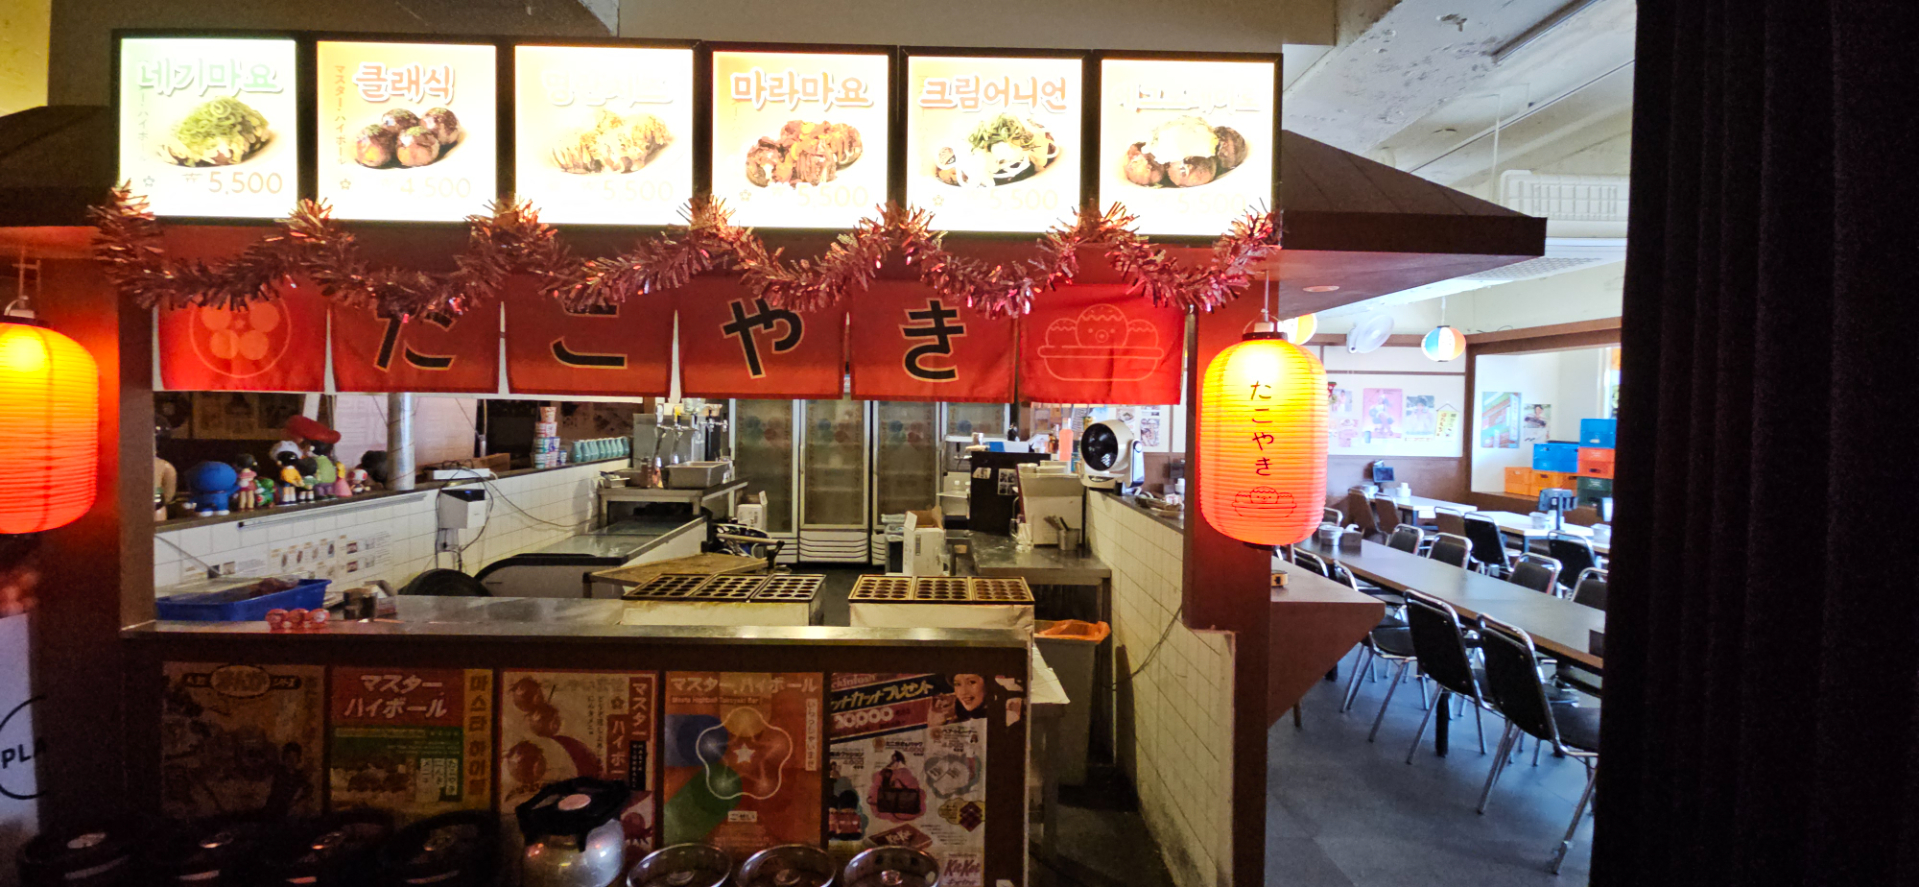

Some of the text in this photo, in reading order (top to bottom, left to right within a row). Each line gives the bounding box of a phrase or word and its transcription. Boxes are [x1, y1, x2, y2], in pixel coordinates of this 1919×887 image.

[139, 57, 283, 96] 네기마요
[355, 62, 454, 102] 클래식
[733, 69, 872, 108] 마라마요
[919, 74, 1067, 111] 크림어니언
[1250, 380, 1275, 477] たこやき
[344, 697, 448, 719] ハイボール
[631, 682, 649, 737] マスター
[611, 720, 627, 781] ハイボー
